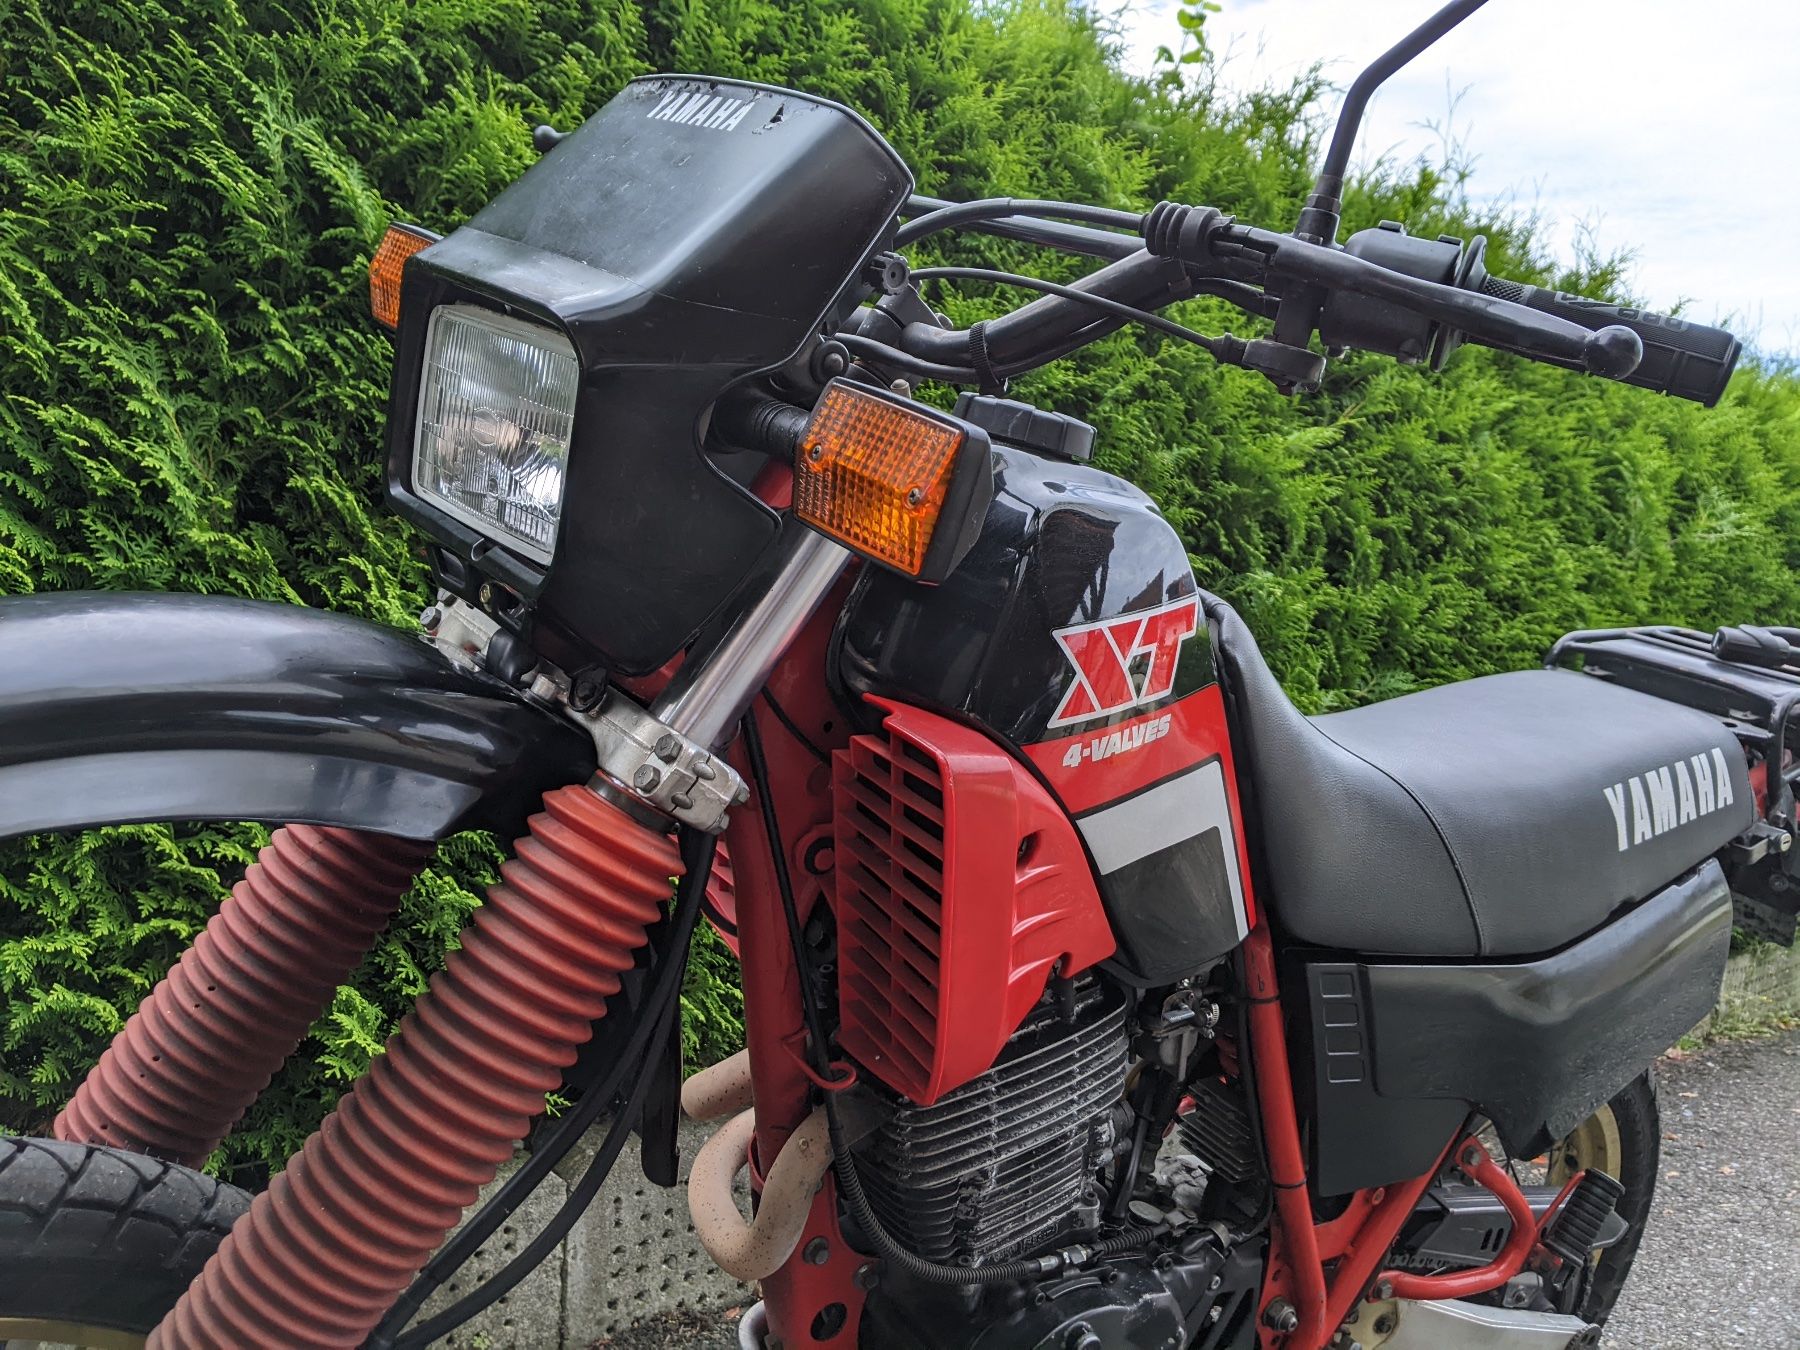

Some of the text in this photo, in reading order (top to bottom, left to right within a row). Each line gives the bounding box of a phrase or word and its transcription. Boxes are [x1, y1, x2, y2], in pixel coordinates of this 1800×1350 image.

[646, 91, 755, 131] YAMAHA
[1047, 595, 1199, 729] XT
[1062, 713, 1172, 768] 4-VALVES
[1603, 747, 1733, 851] YAMAHA
